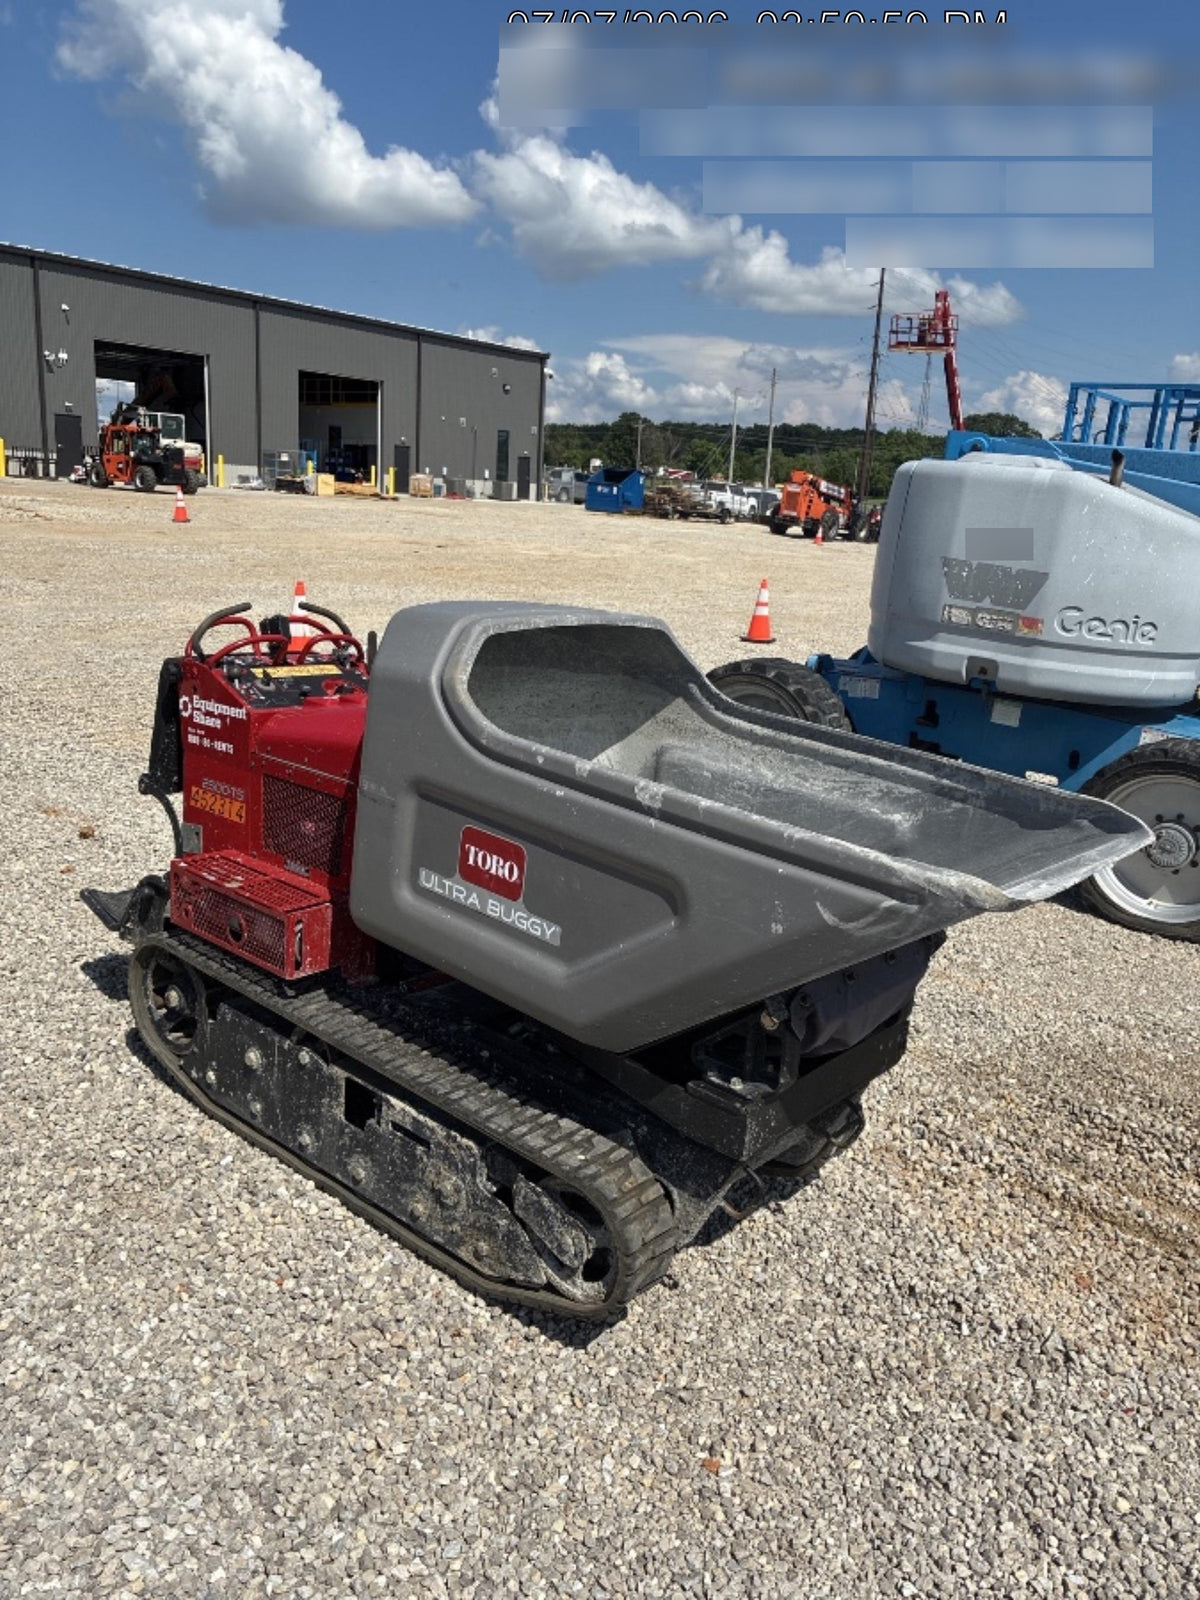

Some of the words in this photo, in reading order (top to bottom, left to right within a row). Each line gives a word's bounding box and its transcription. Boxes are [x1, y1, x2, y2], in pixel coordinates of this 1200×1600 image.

[1054, 606, 1158, 645] Genie
[193, 695, 247, 720] Equipment
[193, 710, 221, 729] Share
[465, 844, 519, 882] TORO
[422, 869, 481, 910] ULTRA
[487, 899, 556, 940] BUGGY
